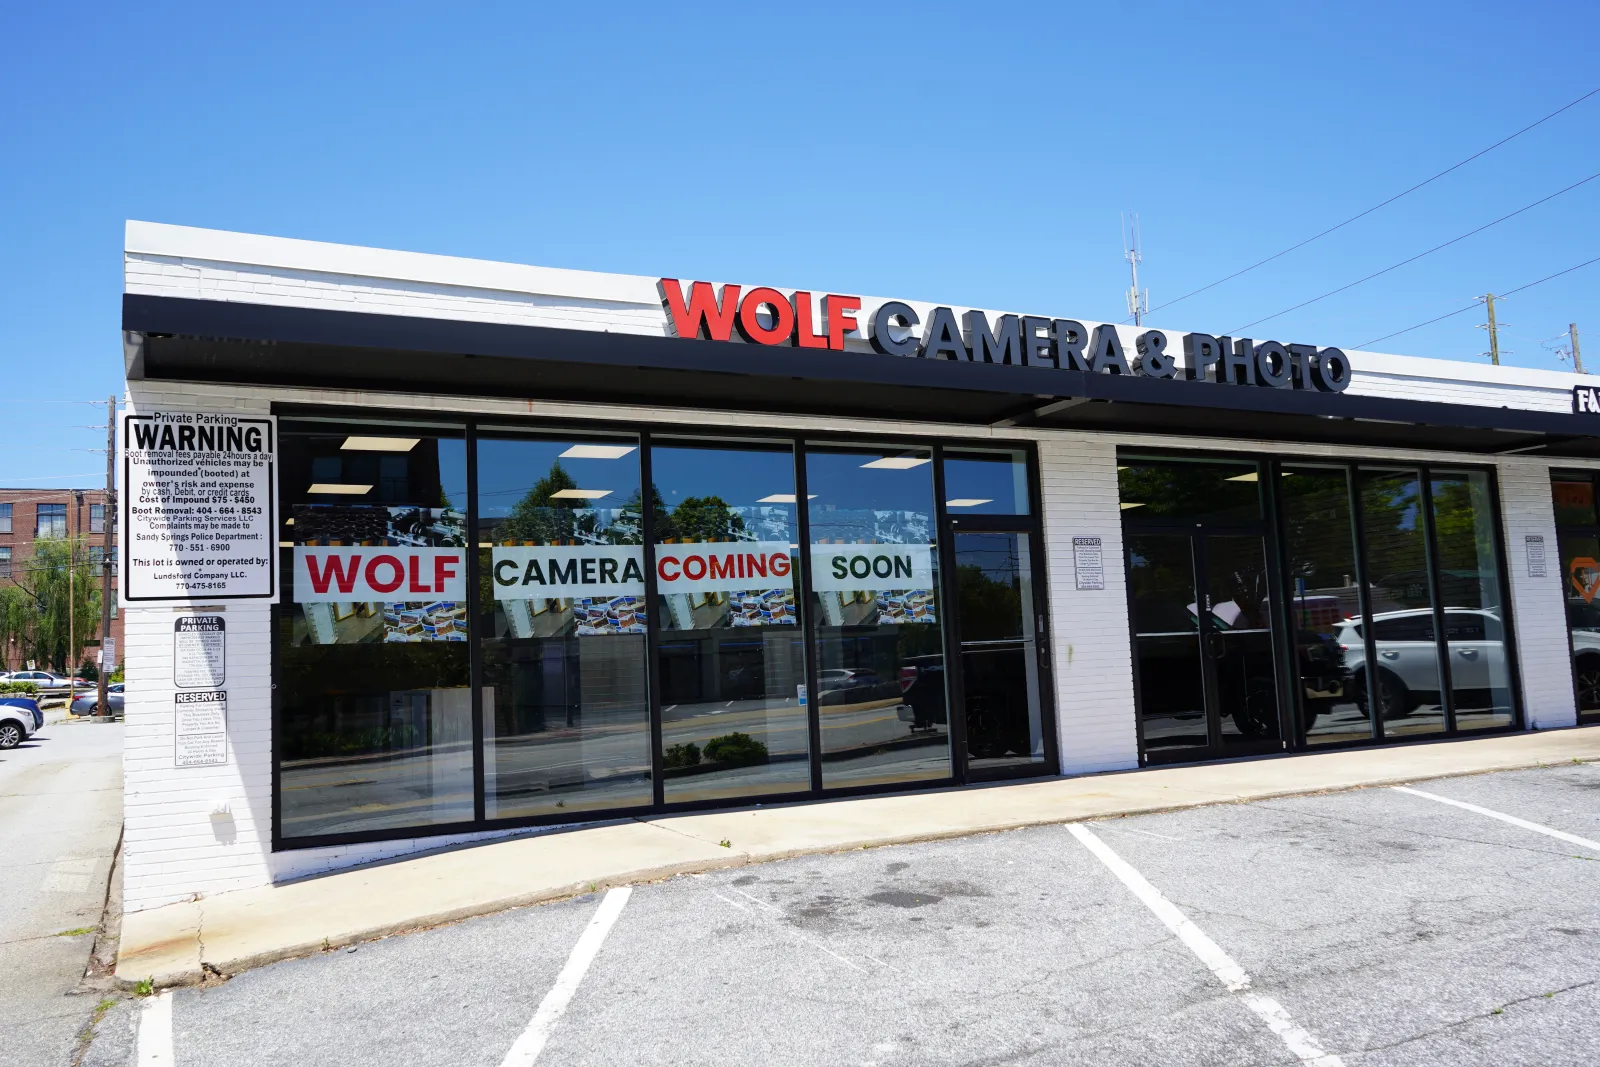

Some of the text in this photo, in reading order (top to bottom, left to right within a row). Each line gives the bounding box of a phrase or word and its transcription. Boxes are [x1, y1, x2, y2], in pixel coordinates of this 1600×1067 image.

[658, 277, 1351, 393] WOLF CAMERA & PHOTO
[1577, 388, 1600, 413] FA
[154, 412, 239, 427] Private Parking
[133, 423, 262, 452] WARNING
[125, 448, 142, 458] Boot
[144, 449, 174, 458] removal
[176, 450, 192, 458] fees
[192, 450, 221, 460] payable
[222, 450, 251, 460] 24hours
[133, 458, 194, 466] Unauthorized
[196, 458, 232, 466] vehicles
[234, 460, 251, 468] may
[148, 469, 198, 478] impounded
[200, 469, 238, 478] (booted)
[142, 480, 179, 488] owner's
[182, 480, 198, 488] risk
[218, 482, 255, 490] expense
[141, 488, 151, 496] by
[152, 488, 172, 496] cash,
[175, 488, 196, 496] Debit,
[208, 488, 228, 496] credit
[230, 488, 250, 497] cards
[172, 496, 210, 505] Impound
[212, 496, 228, 504] $75
[234, 496, 255, 504] $450
[150, 522, 192, 530] Complaints
[136, 533, 159, 542] Sandy
[161, 533, 189, 542] Springs
[216, 533, 258, 542] Department
[133, 558, 150, 567] This
[175, 558, 204, 566] owned
[217, 558, 254, 567] operated
[256, 558, 268, 566] by:
[194, 572, 228, 580] Company
[305, 552, 912, 594] WOLF CAMERA COMING SOON
[177, 692, 226, 702] RESERVED
